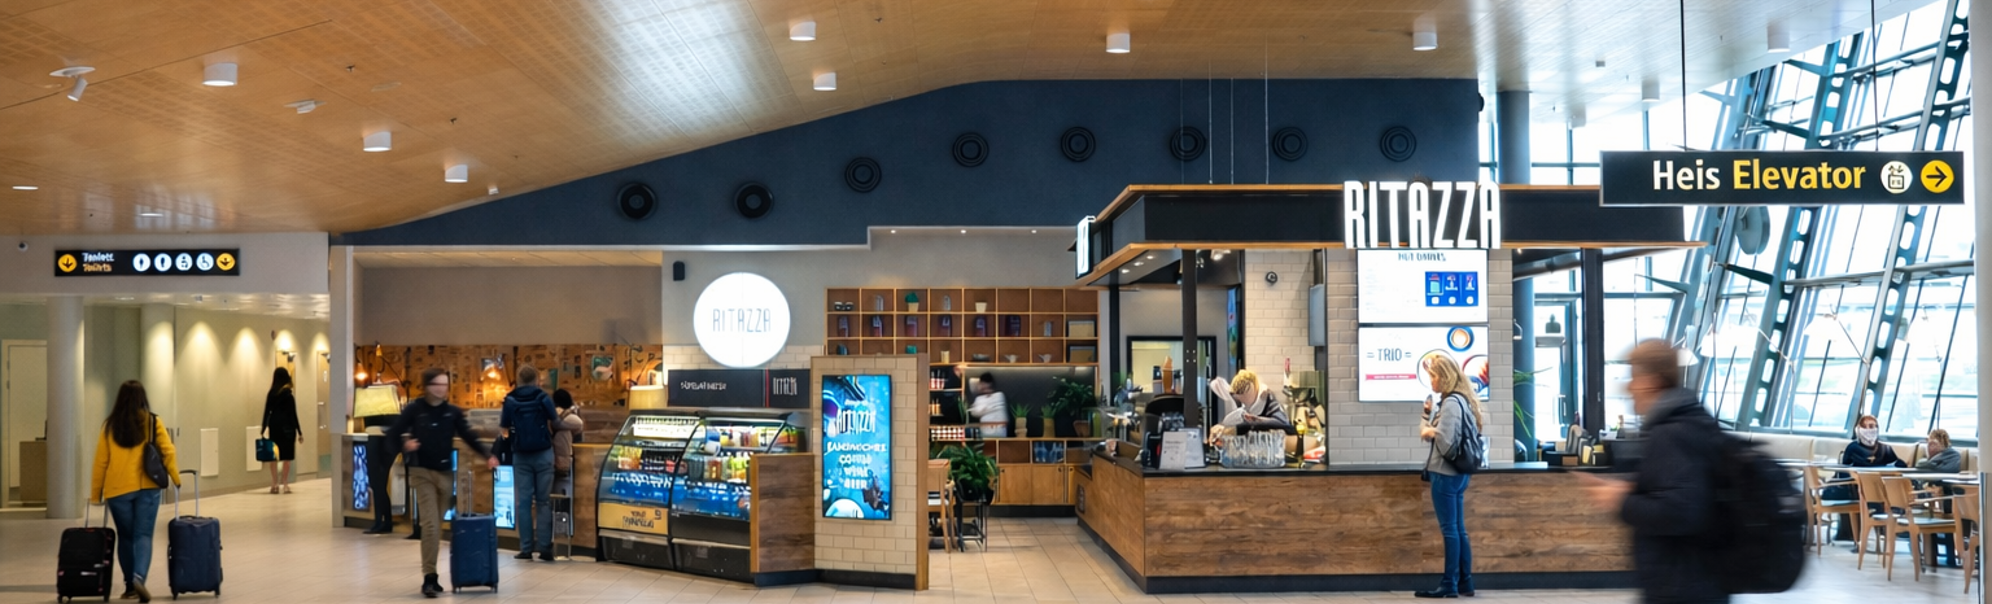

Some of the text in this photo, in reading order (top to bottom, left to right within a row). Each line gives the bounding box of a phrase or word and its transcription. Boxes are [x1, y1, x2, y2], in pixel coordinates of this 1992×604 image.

[1653, 158, 1866, 190] Heis Elevator
[1344, 180, 1501, 249] RITAZZA
[712, 308, 771, 332] RITAZZA
[1377, 348, 1402, 361] TRIO
